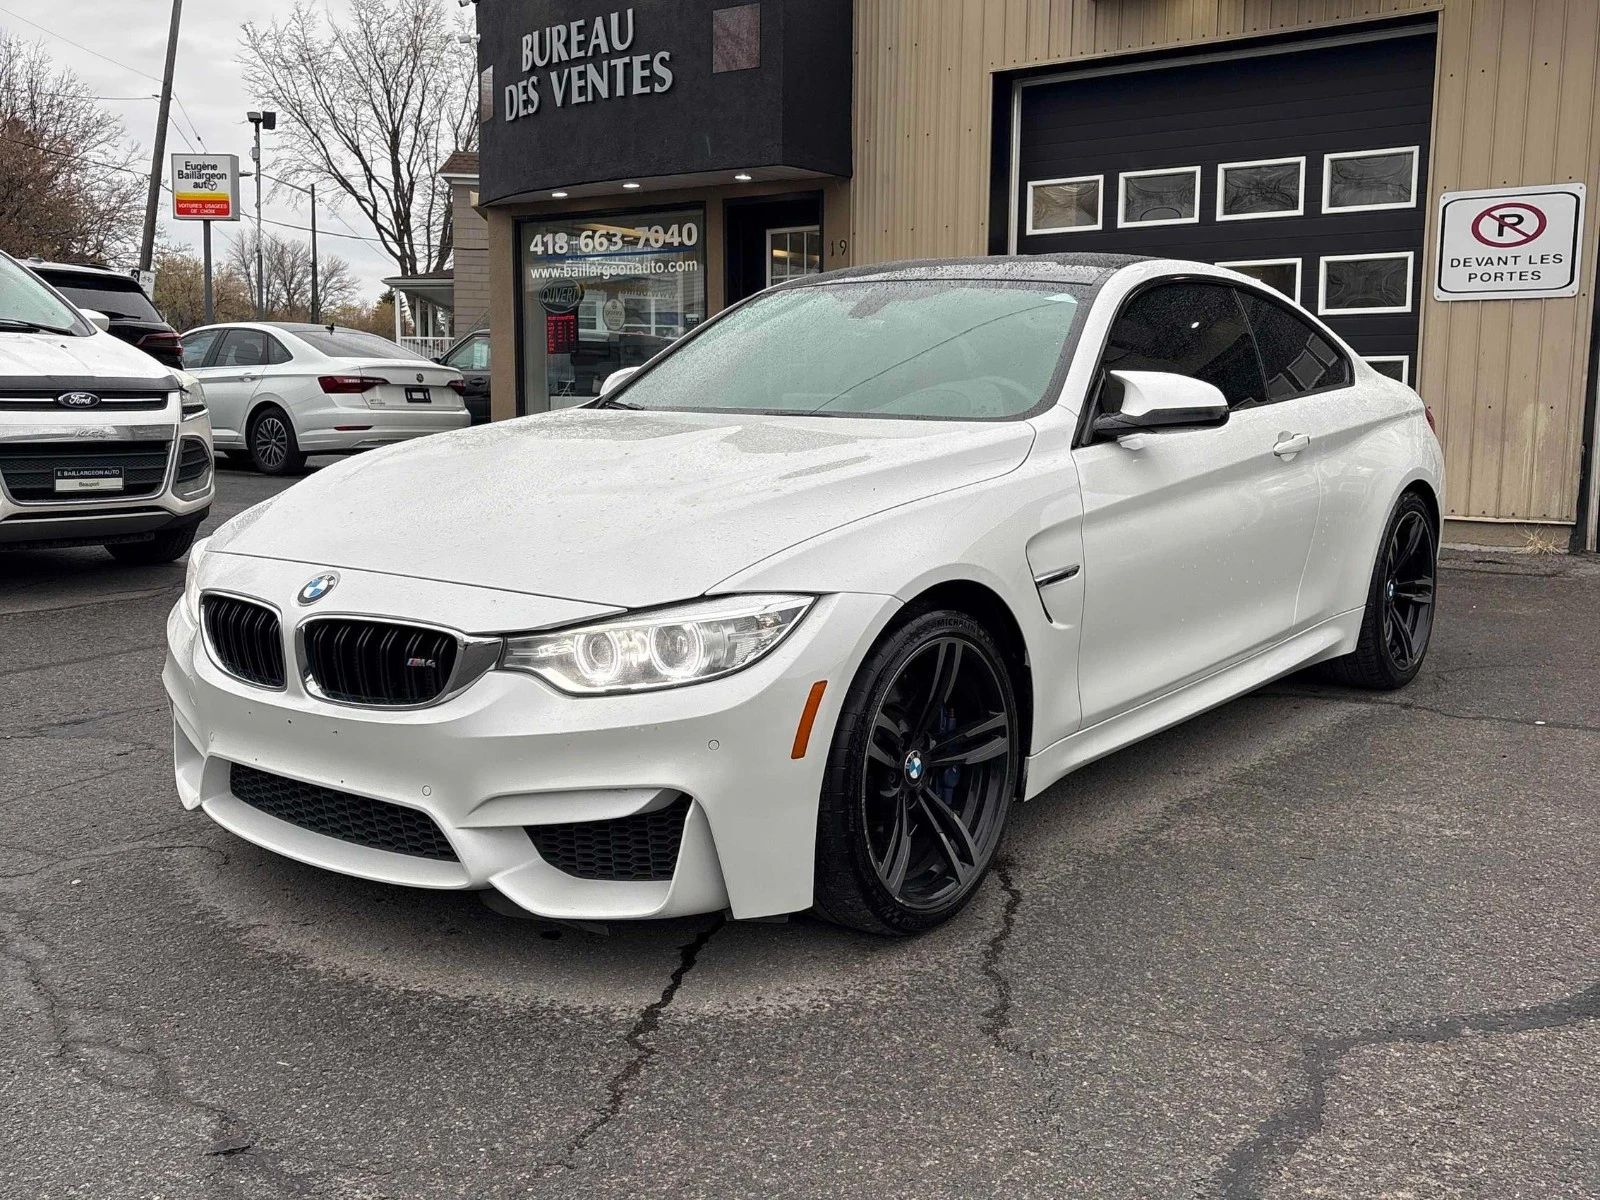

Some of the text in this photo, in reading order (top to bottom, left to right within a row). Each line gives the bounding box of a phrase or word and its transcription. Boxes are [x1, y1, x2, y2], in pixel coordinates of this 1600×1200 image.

[522, 8, 634, 73] BUREAU
[505, 51, 673, 122] DES VENTES
[184, 161, 218, 172] Eugène
[177, 170, 227, 181] Baillargeon
[529, 222, 698, 255] 418-663-7040
[831, 239, 847, 256] 19
[1450, 253, 1564, 268] DEVANT LES
[530, 260, 698, 280] www.baillargeonauto.com
[1468, 270, 1542, 282] PORTES
[541, 287, 578, 303] OUVERT
[69, 393, 92, 405] Ford
[408, 658, 436, 668] M4
